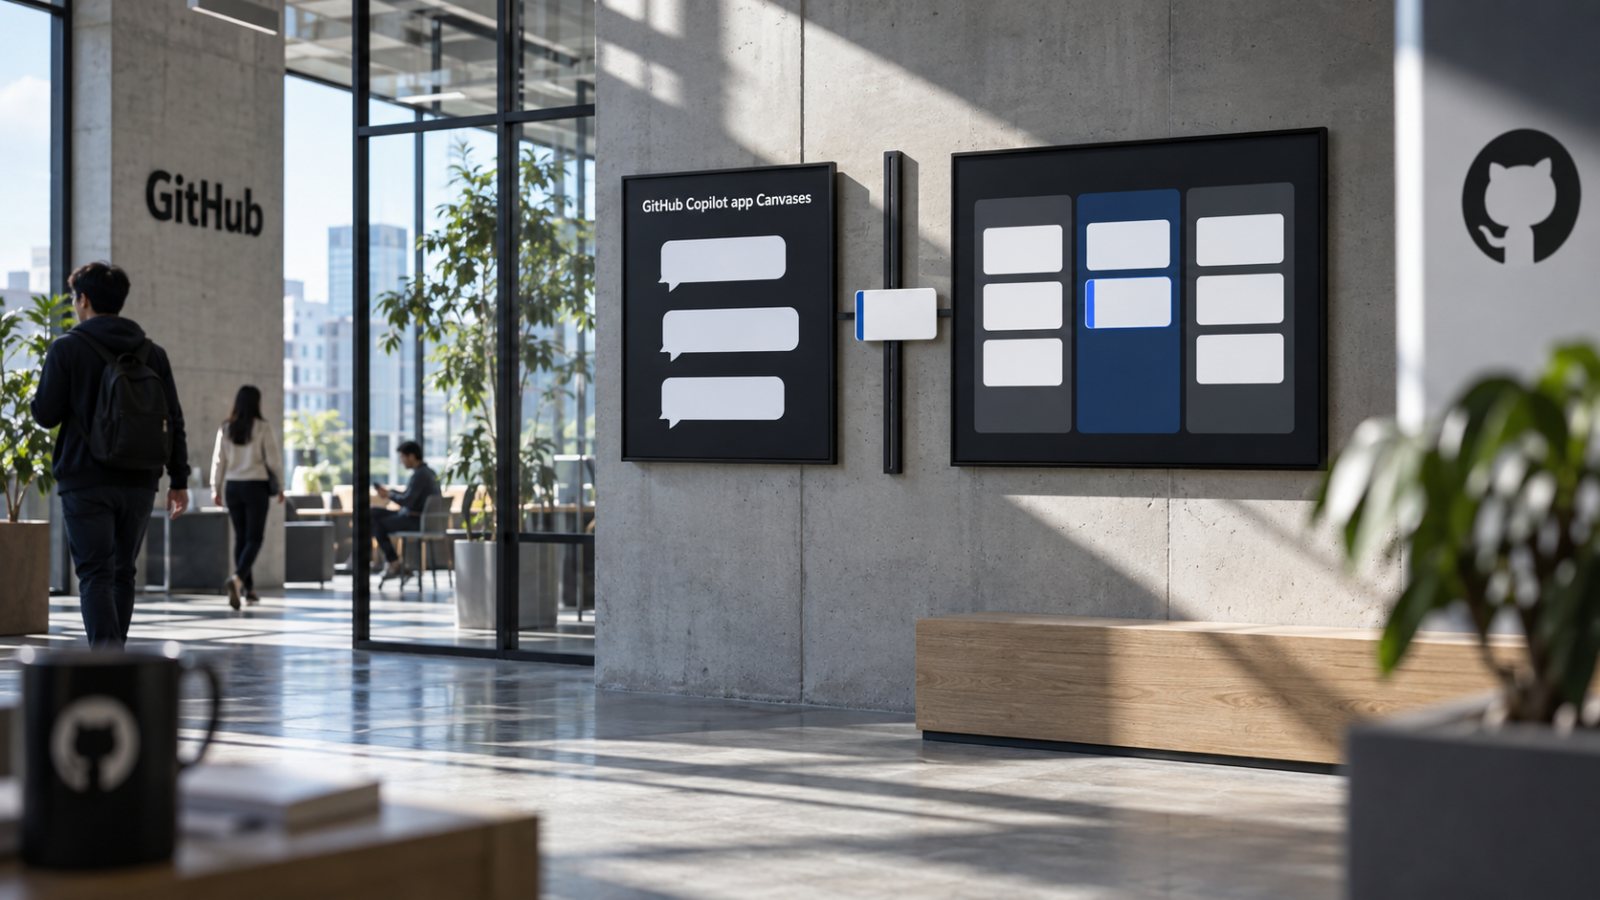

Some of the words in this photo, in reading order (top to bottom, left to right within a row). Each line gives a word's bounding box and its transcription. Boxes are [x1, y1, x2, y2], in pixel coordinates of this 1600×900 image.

[146, 169, 263, 237] GitHub
[642, 198, 683, 213] GitHub
[686, 196, 728, 212] Copilot
[731, 197, 753, 211] app
[756, 193, 811, 207] Canvases
